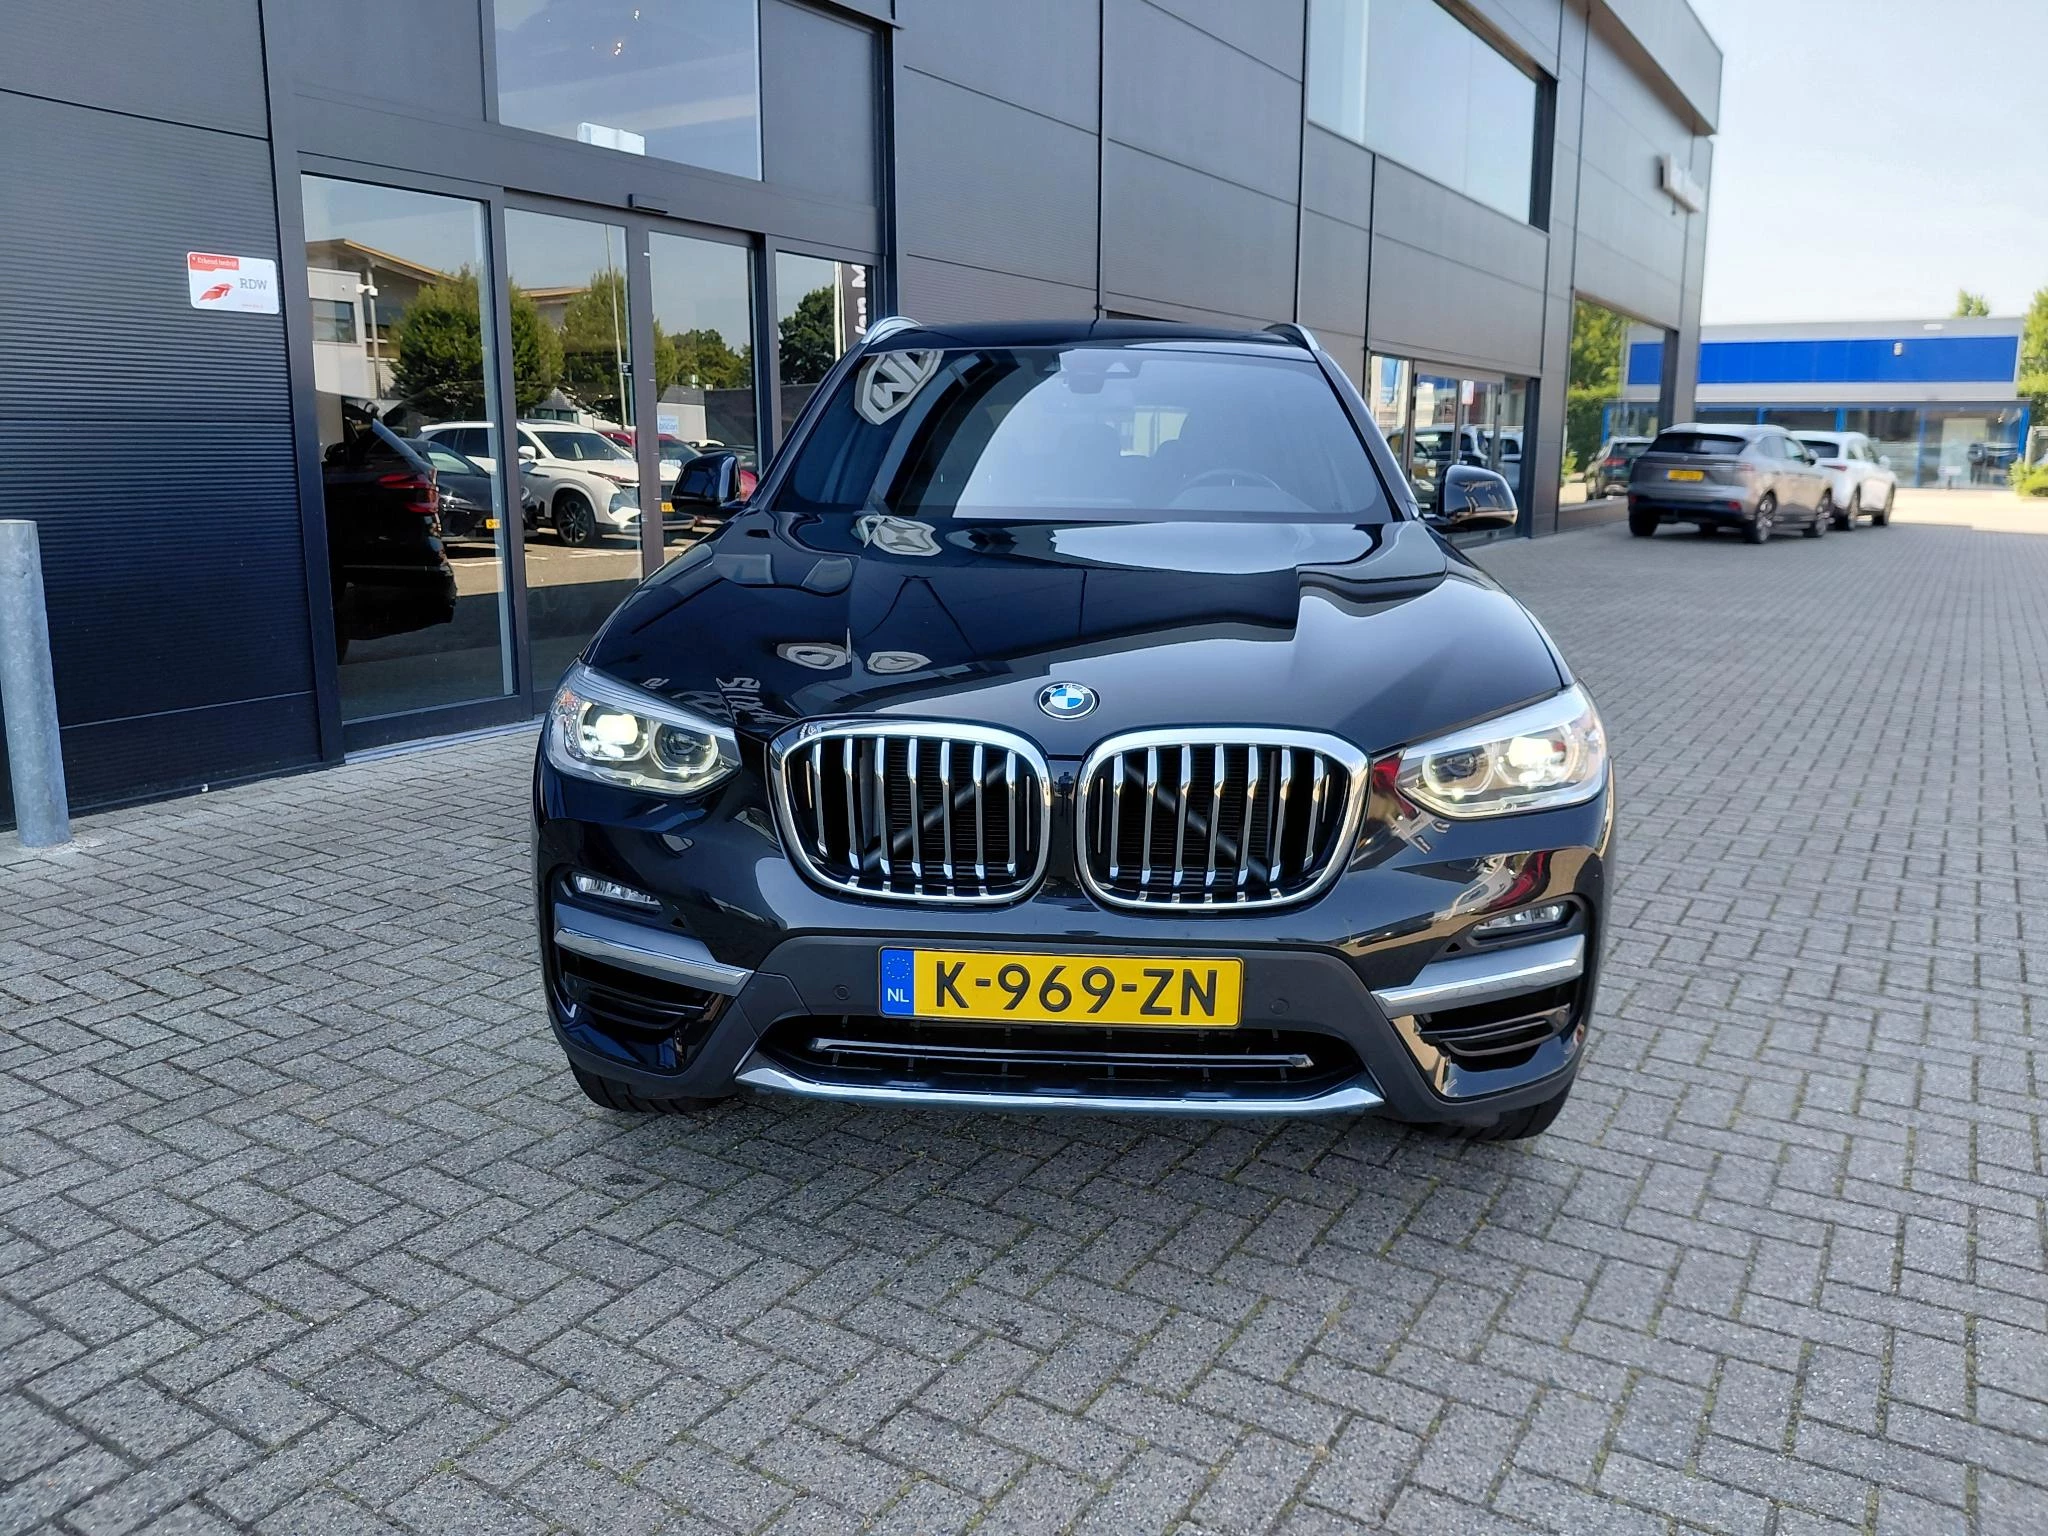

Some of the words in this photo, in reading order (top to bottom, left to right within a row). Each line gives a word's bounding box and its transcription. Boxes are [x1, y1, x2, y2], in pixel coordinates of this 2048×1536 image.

[240, 278, 268, 291] RDW
[887, 987, 910, 1003] NL
[936, 960, 1217, 1016] K-969-ZN
